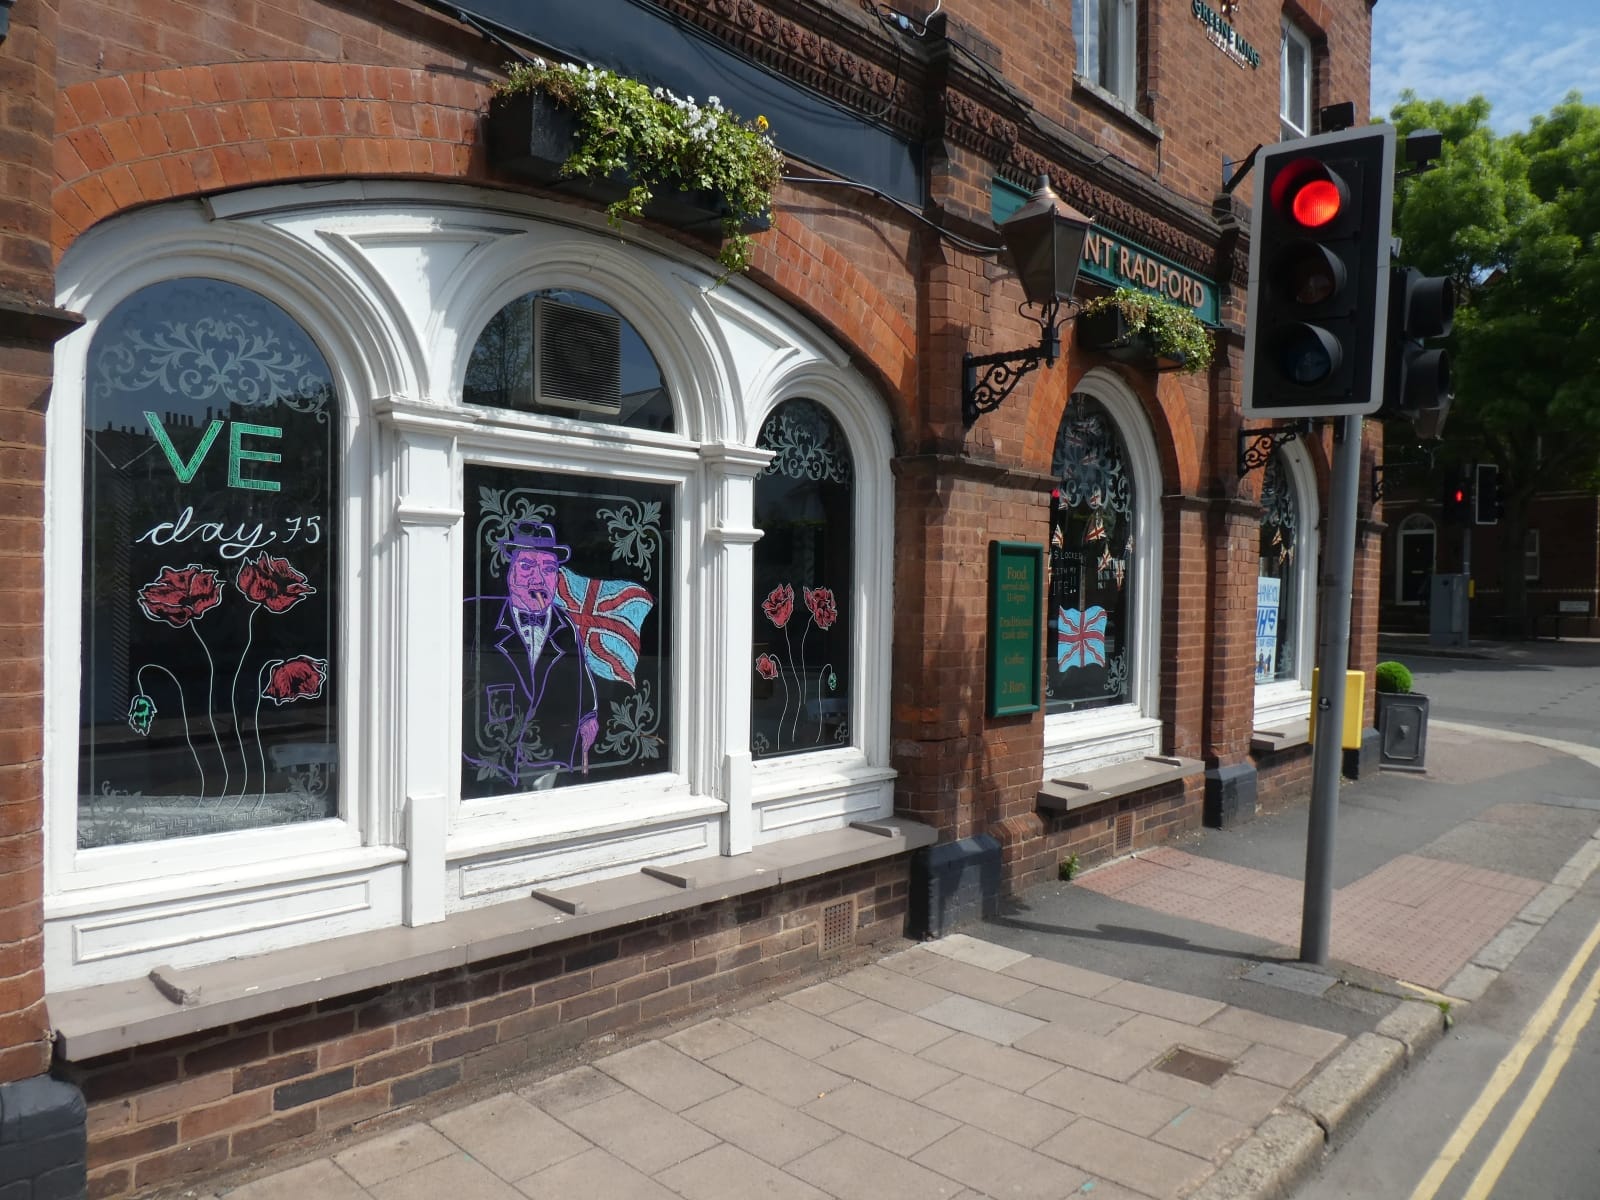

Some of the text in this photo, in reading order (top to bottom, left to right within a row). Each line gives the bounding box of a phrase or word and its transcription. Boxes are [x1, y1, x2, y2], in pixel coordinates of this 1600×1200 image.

[1191, 0, 1234, 44] GREENE
[1235, 32, 1260, 68] KING
[1084, 231, 1204, 308] NT RADFORD
[143, 410, 283, 491] VE
[281, 515, 322, 544] 75
[1007, 565, 1027, 580] Food
